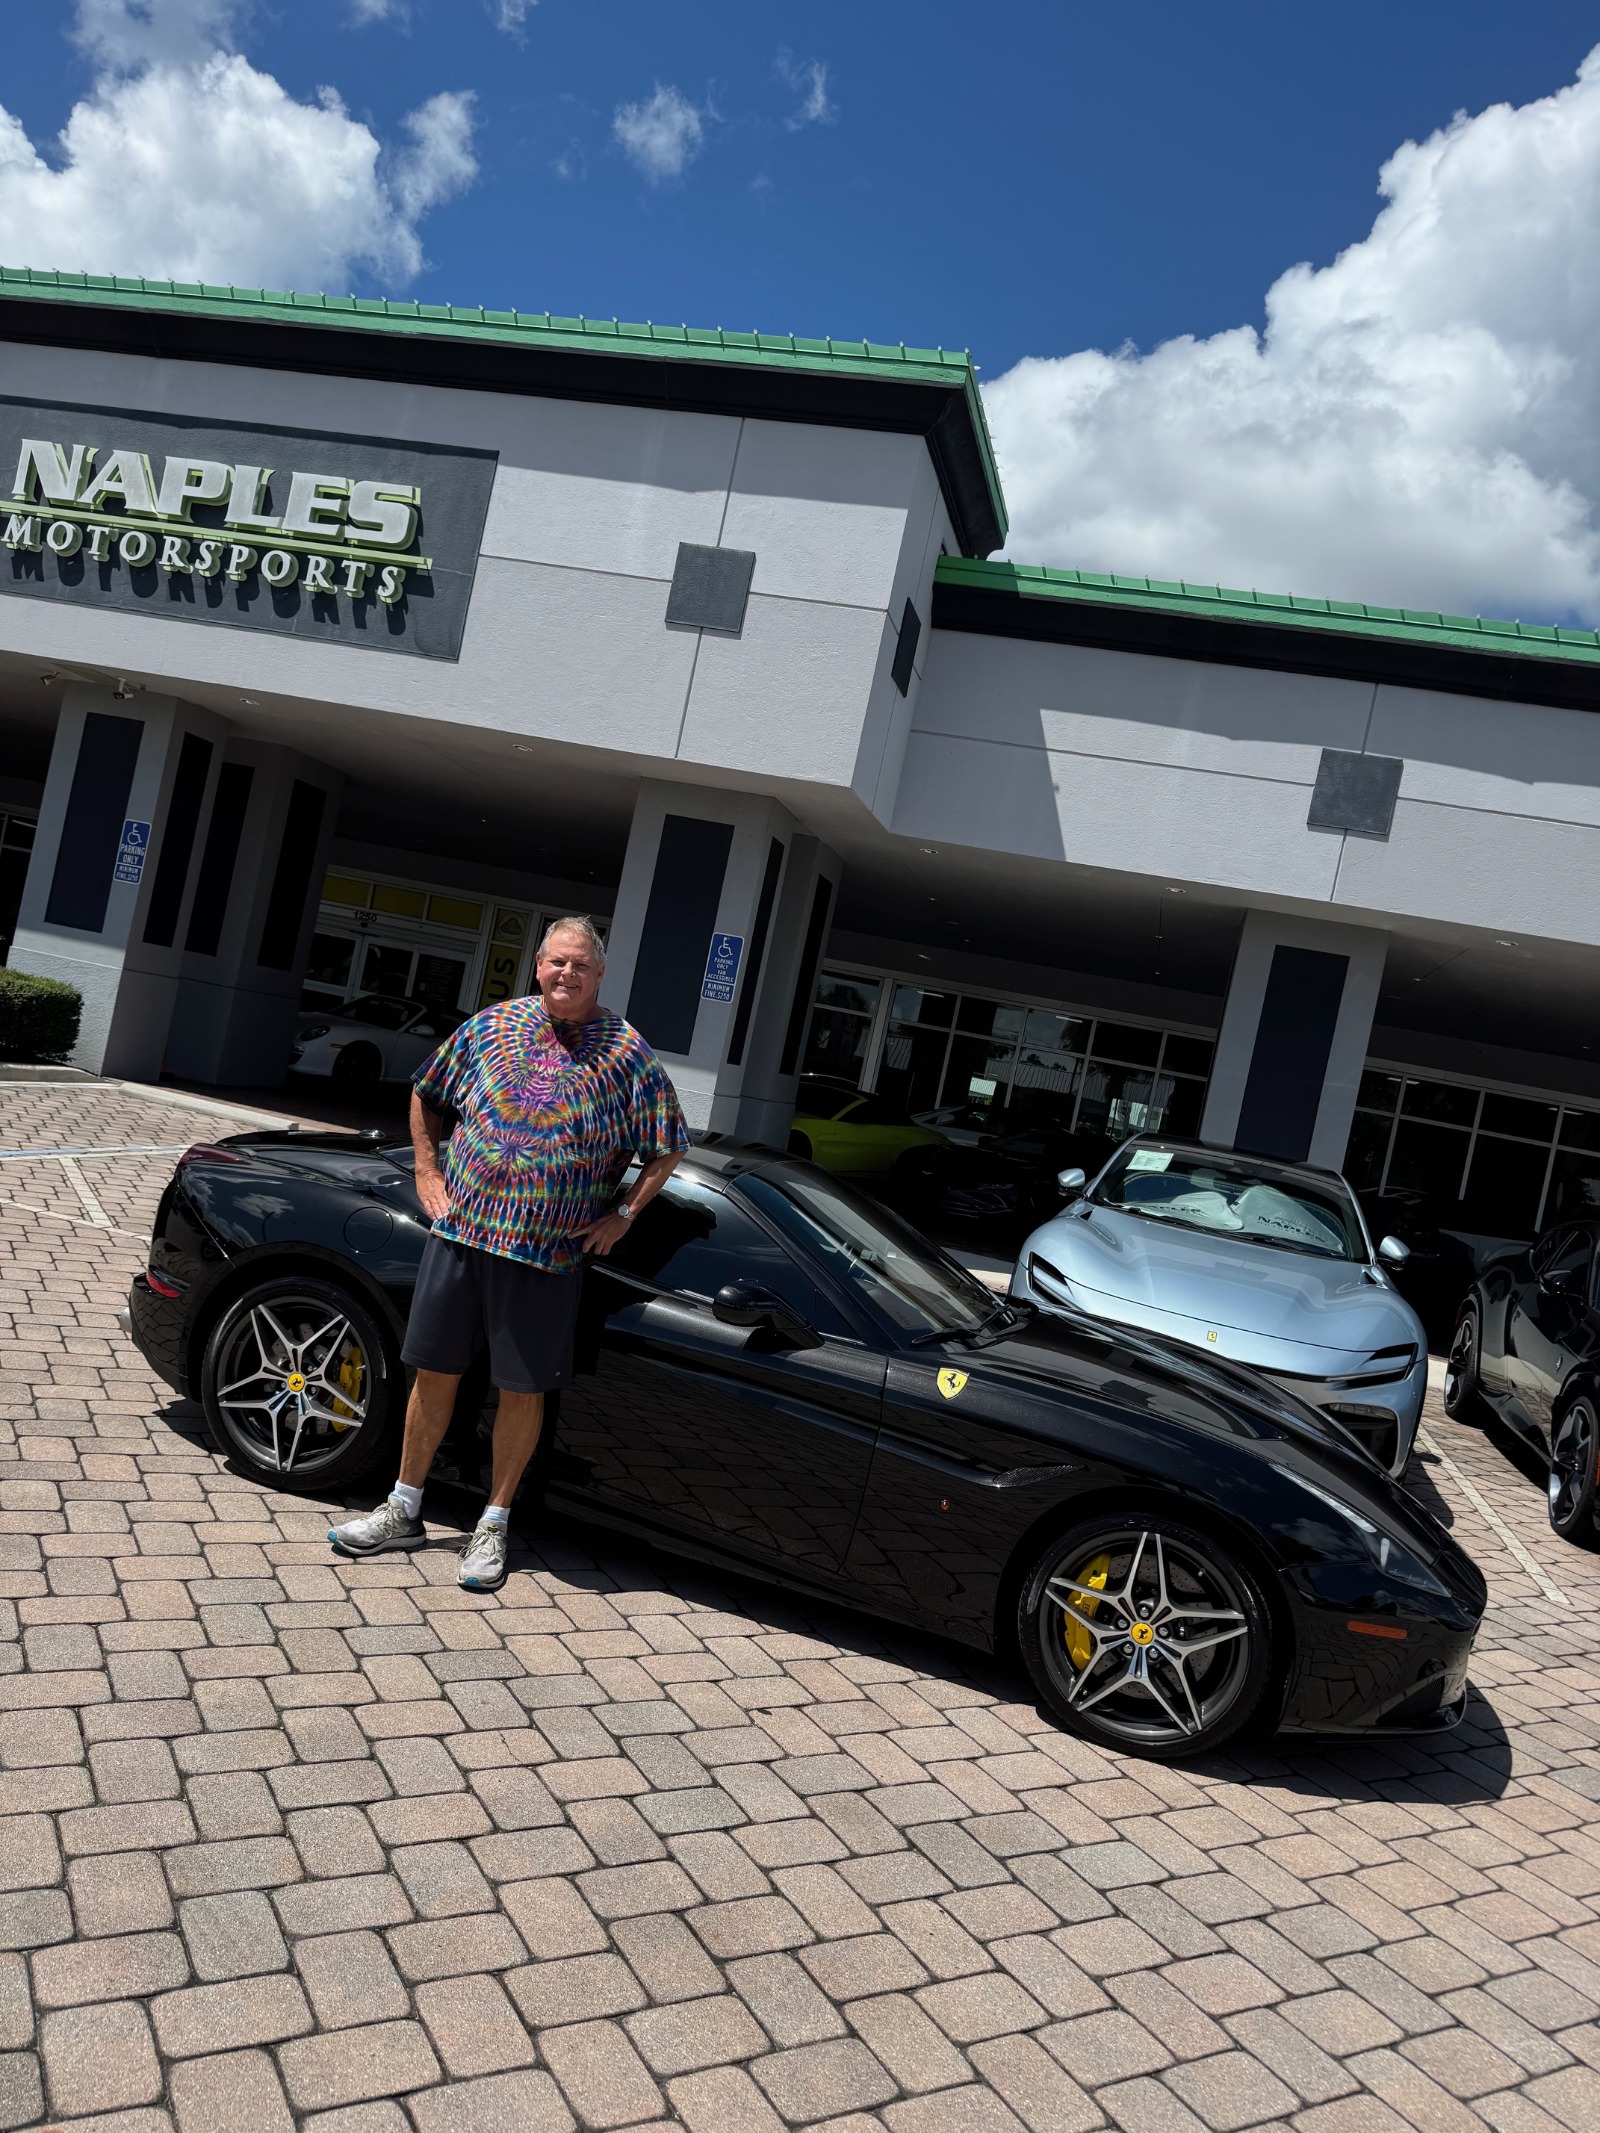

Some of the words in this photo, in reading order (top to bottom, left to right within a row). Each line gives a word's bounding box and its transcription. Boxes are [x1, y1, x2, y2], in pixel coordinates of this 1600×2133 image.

[12, 438, 421, 550] NAPLES
[1, 513, 404, 603] MOTORSPORTS
[120, 844, 145, 856] PARKING
[123, 854, 139, 865] ONLY
[119, 866, 139, 874] MINIMUM
[354, 911, 377, 922] 1250
[714, 957, 733, 965] PARKING
[707, 973, 734, 982] ACCESSIBLE
[708, 983, 730, 992] MINIMUM
